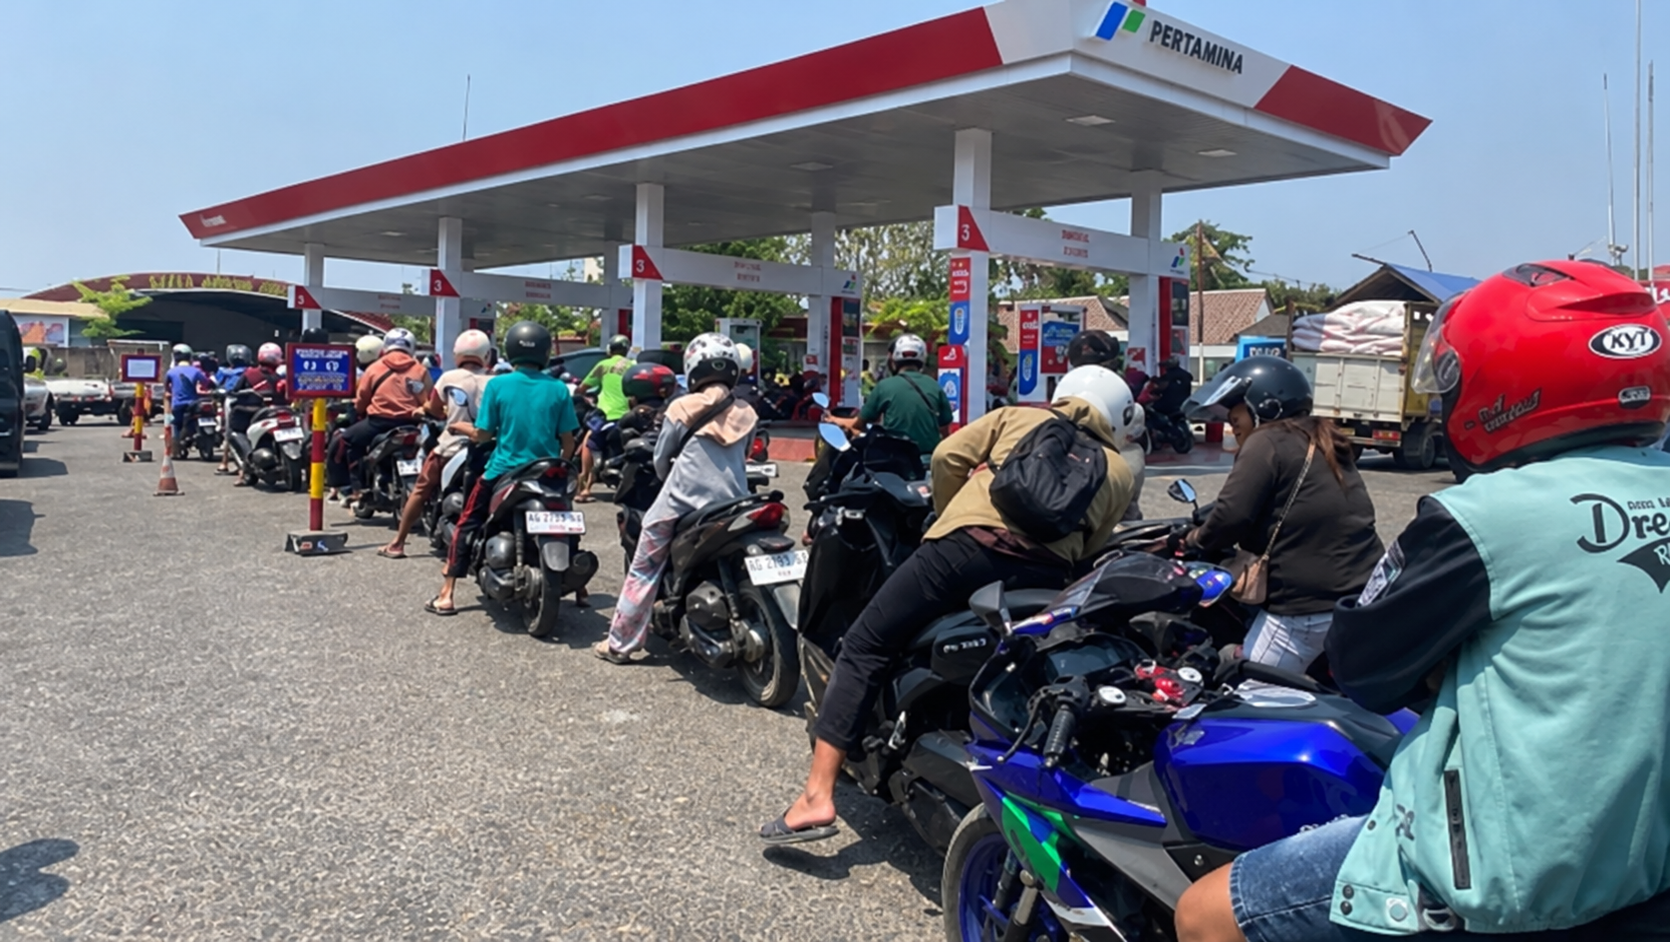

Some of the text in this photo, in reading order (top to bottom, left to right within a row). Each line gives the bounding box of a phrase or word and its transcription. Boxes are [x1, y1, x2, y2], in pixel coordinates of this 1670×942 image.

[1149, 20, 1244, 75] PERTAMINA
[961, 224, 971, 241] 3
[635, 259, 645, 273] 3
[434, 280, 443, 292] 3
[297, 295, 305, 305] 3
[1610, 331, 1648, 350] KYT
[1569, 493, 1670, 554] Dre
